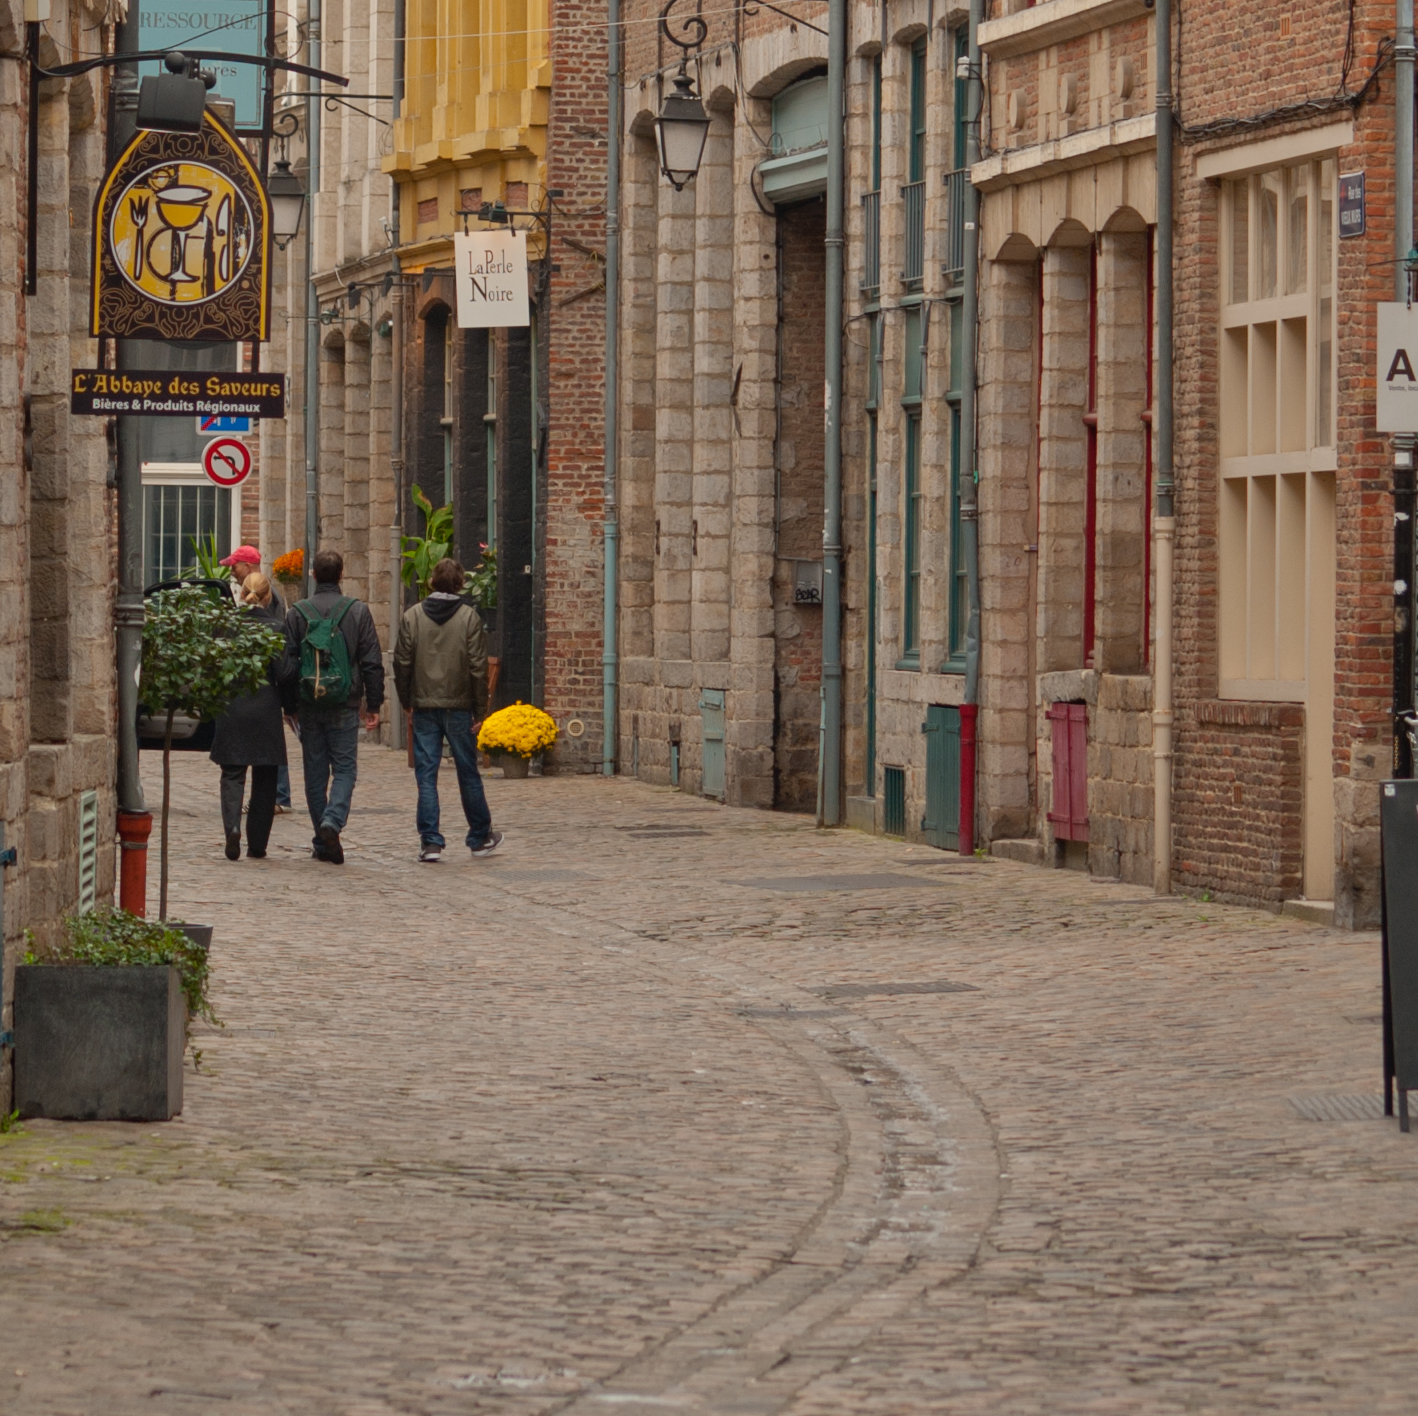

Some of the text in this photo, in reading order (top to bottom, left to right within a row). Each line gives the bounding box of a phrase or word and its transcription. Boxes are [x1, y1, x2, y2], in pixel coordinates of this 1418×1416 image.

[140, 11, 257, 30] RESSOURCE
[467, 248, 514, 275] La Perle
[469, 276, 514, 303] Noire
[74, 374, 281, 397] L'Abbaye des Saveurs
[92, 398, 261, 414] Bières & Produits Régionaux
